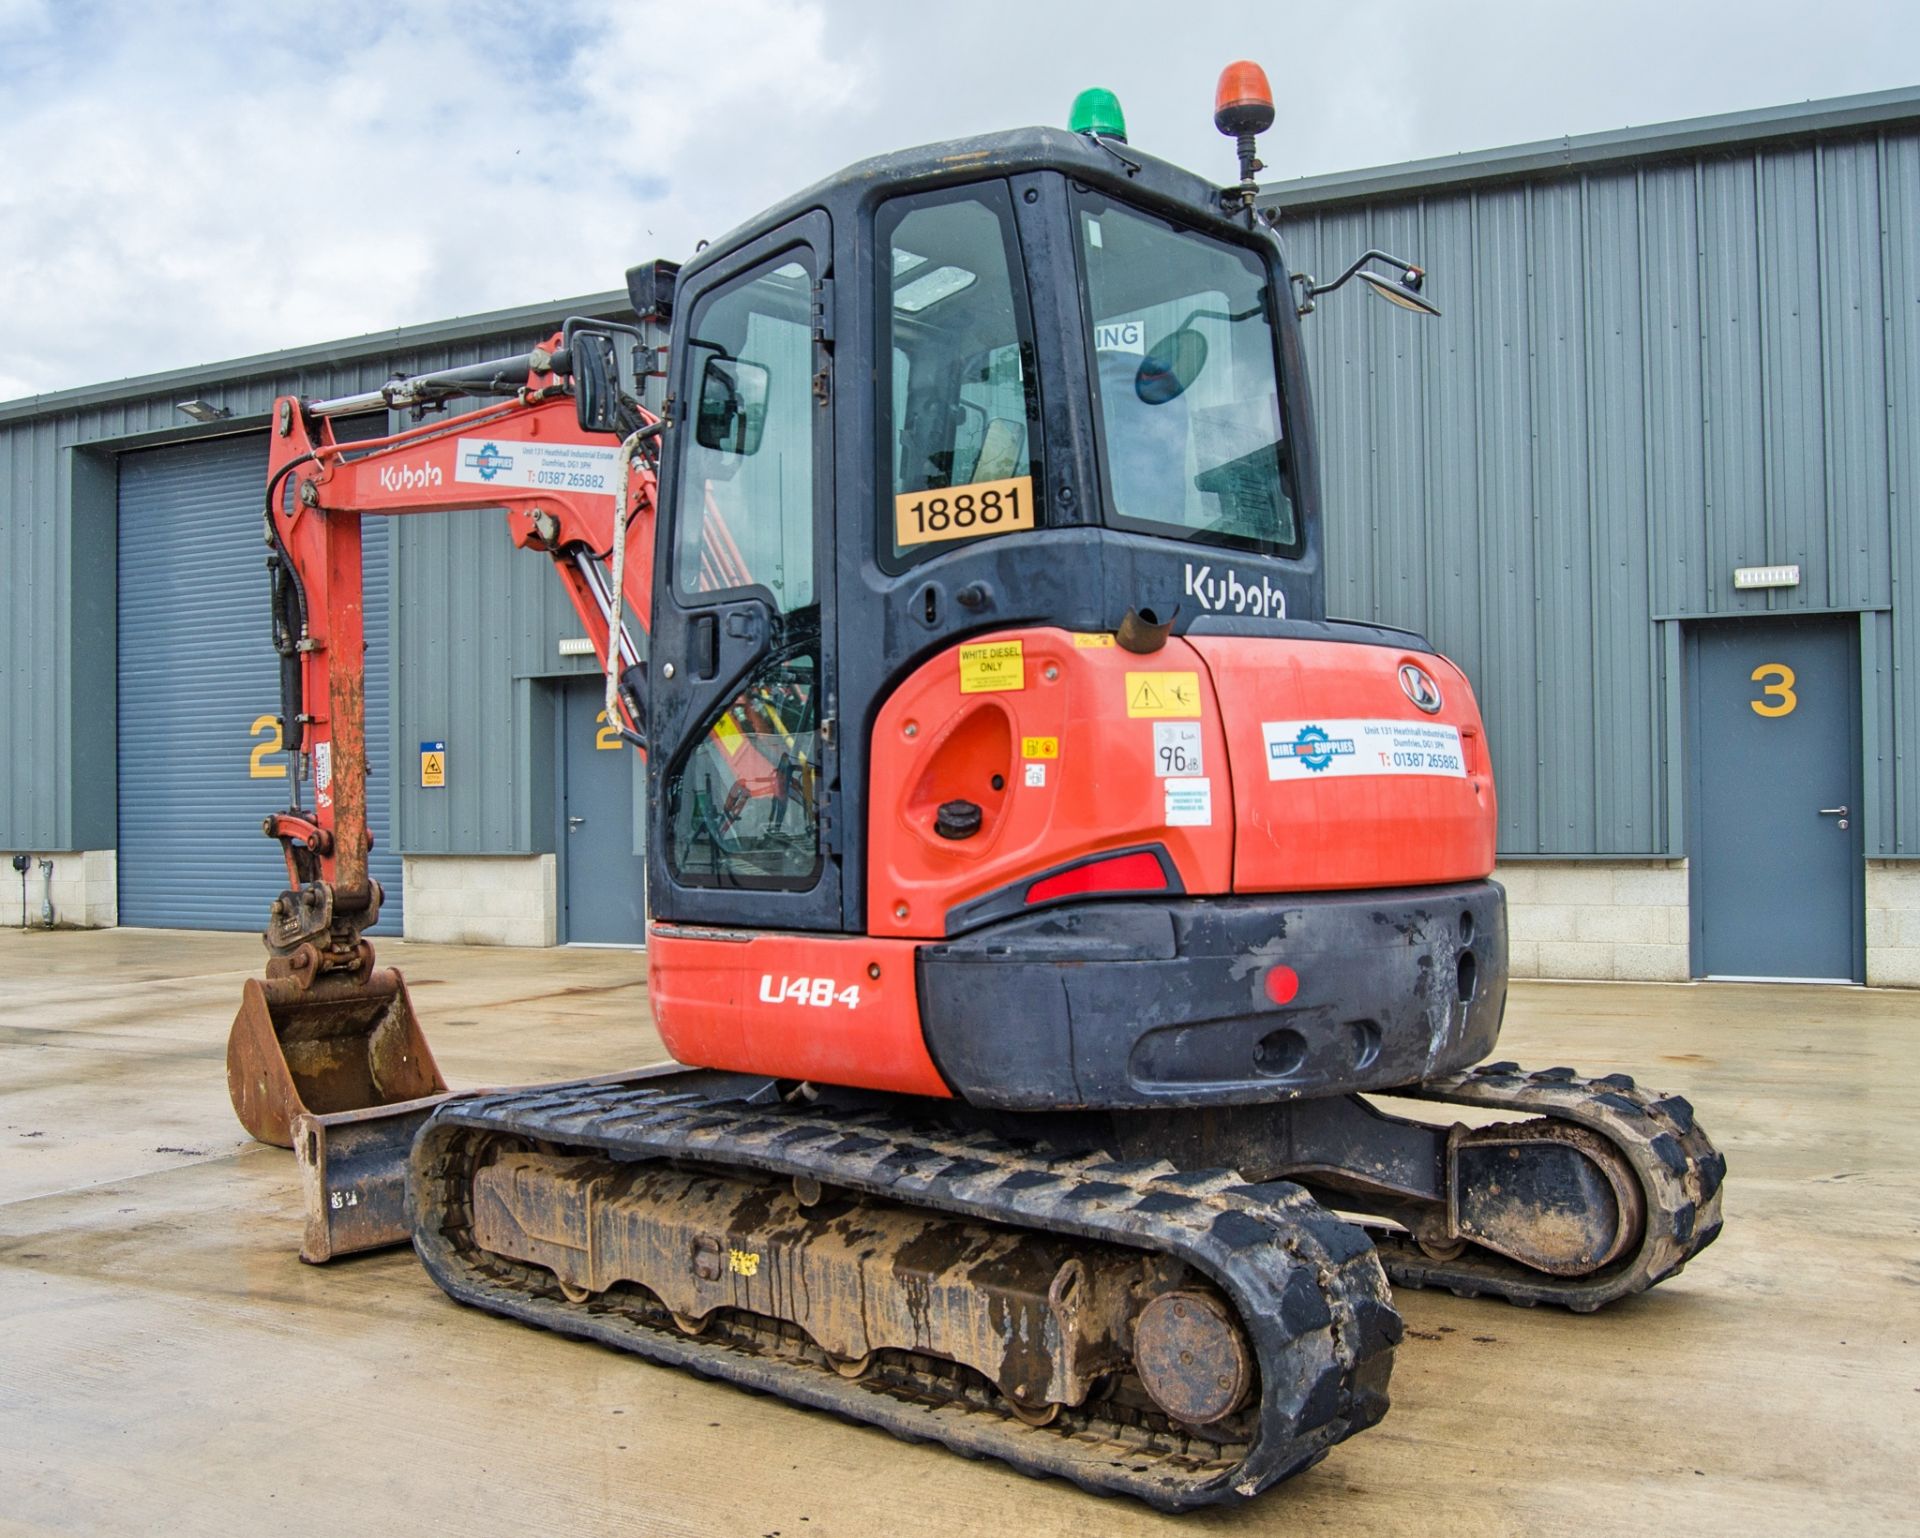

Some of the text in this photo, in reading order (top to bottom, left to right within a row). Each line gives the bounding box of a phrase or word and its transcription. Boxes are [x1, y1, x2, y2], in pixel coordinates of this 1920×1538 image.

[380, 460, 442, 492] Kubota
[527, 470, 605, 488] T: 01387 265882
[910, 487, 1020, 533] 18881
[1185, 563, 1286, 620] Kubota
[961, 646, 1021, 660] WHITE DIESEL
[980, 661, 1003, 672] ONLY
[1751, 663, 1797, 718] 3
[596, 710, 624, 750] 2
[1364, 726, 1380, 735] Unit
[1381, 727, 1392, 735] 131
[250, 715, 287, 778] 2
[1160, 746, 1199, 772] 96 dB
[1272, 743, 1295, 757] HIRE
[1314, 741, 1354, 755] SUPPLIES
[1378, 752, 1460, 770] T: 01387 265882
